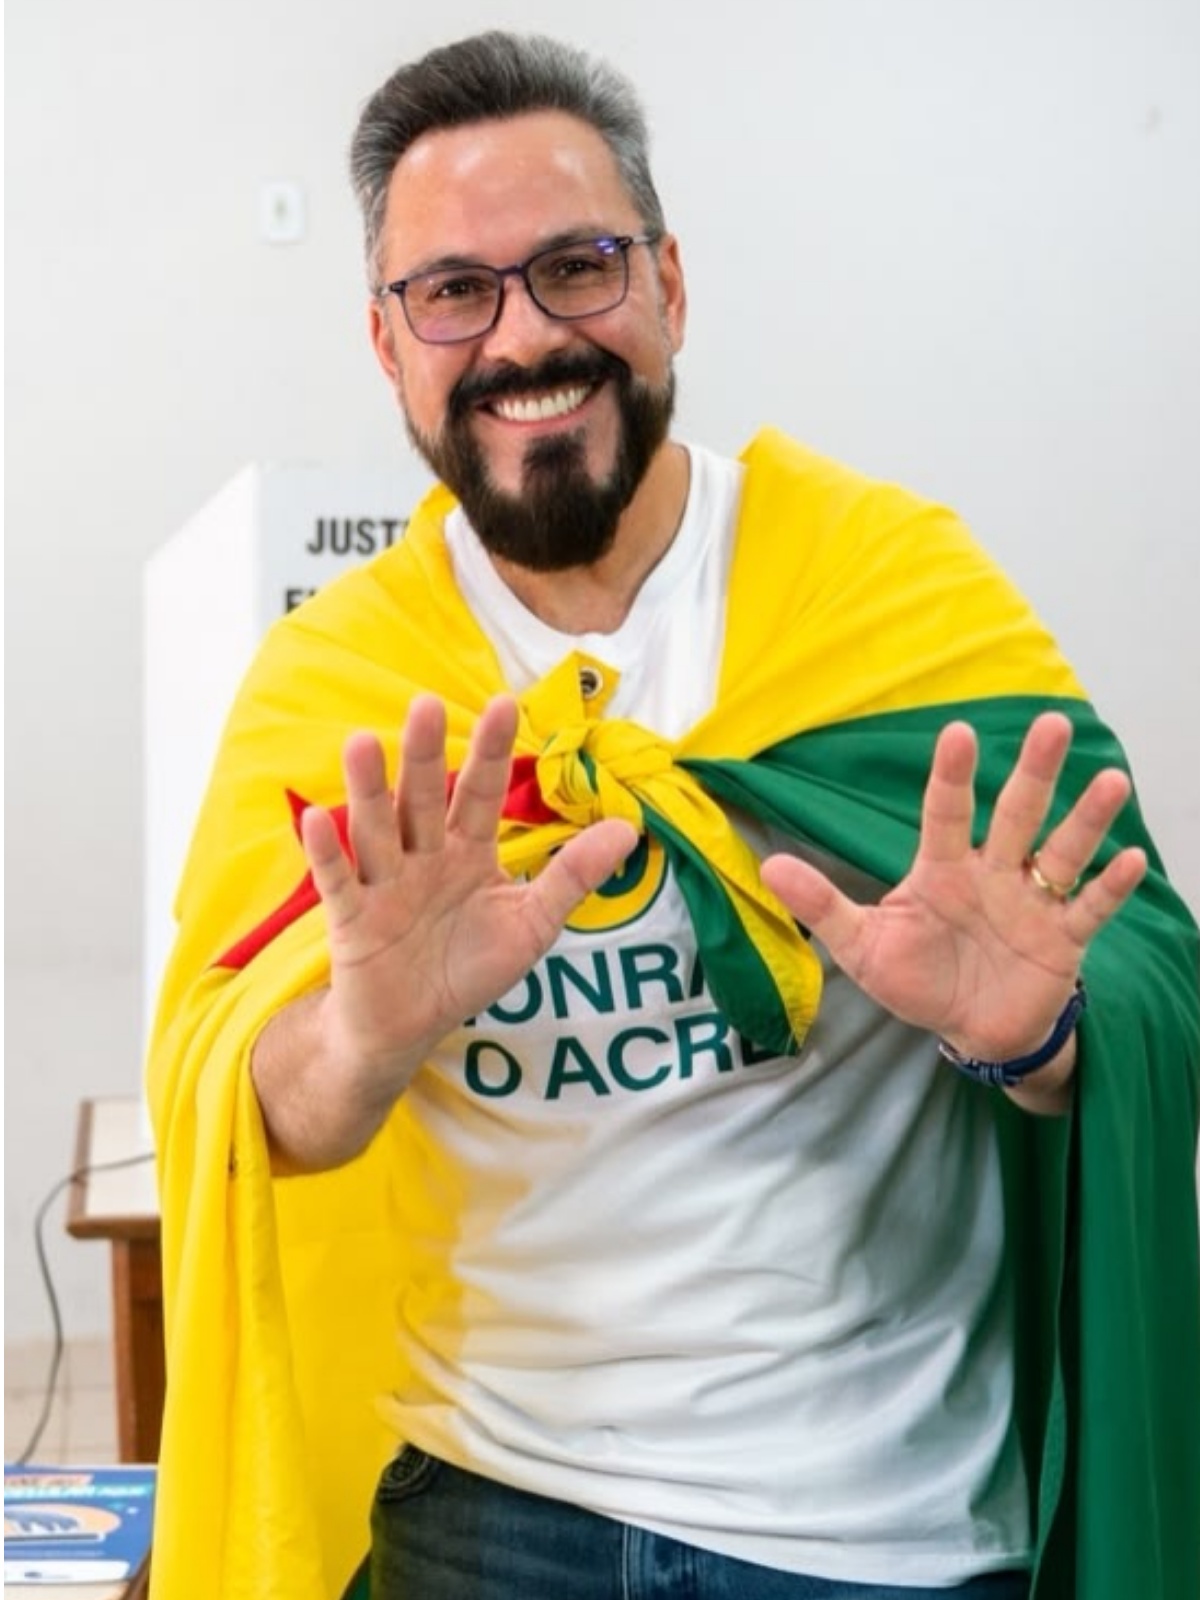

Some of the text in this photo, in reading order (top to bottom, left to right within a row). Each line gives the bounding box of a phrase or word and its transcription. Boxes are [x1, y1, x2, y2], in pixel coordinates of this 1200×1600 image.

[307, 518, 411, 555] JUST
[464, 943, 705, 1028] ONR
[464, 1040, 522, 1098] O
